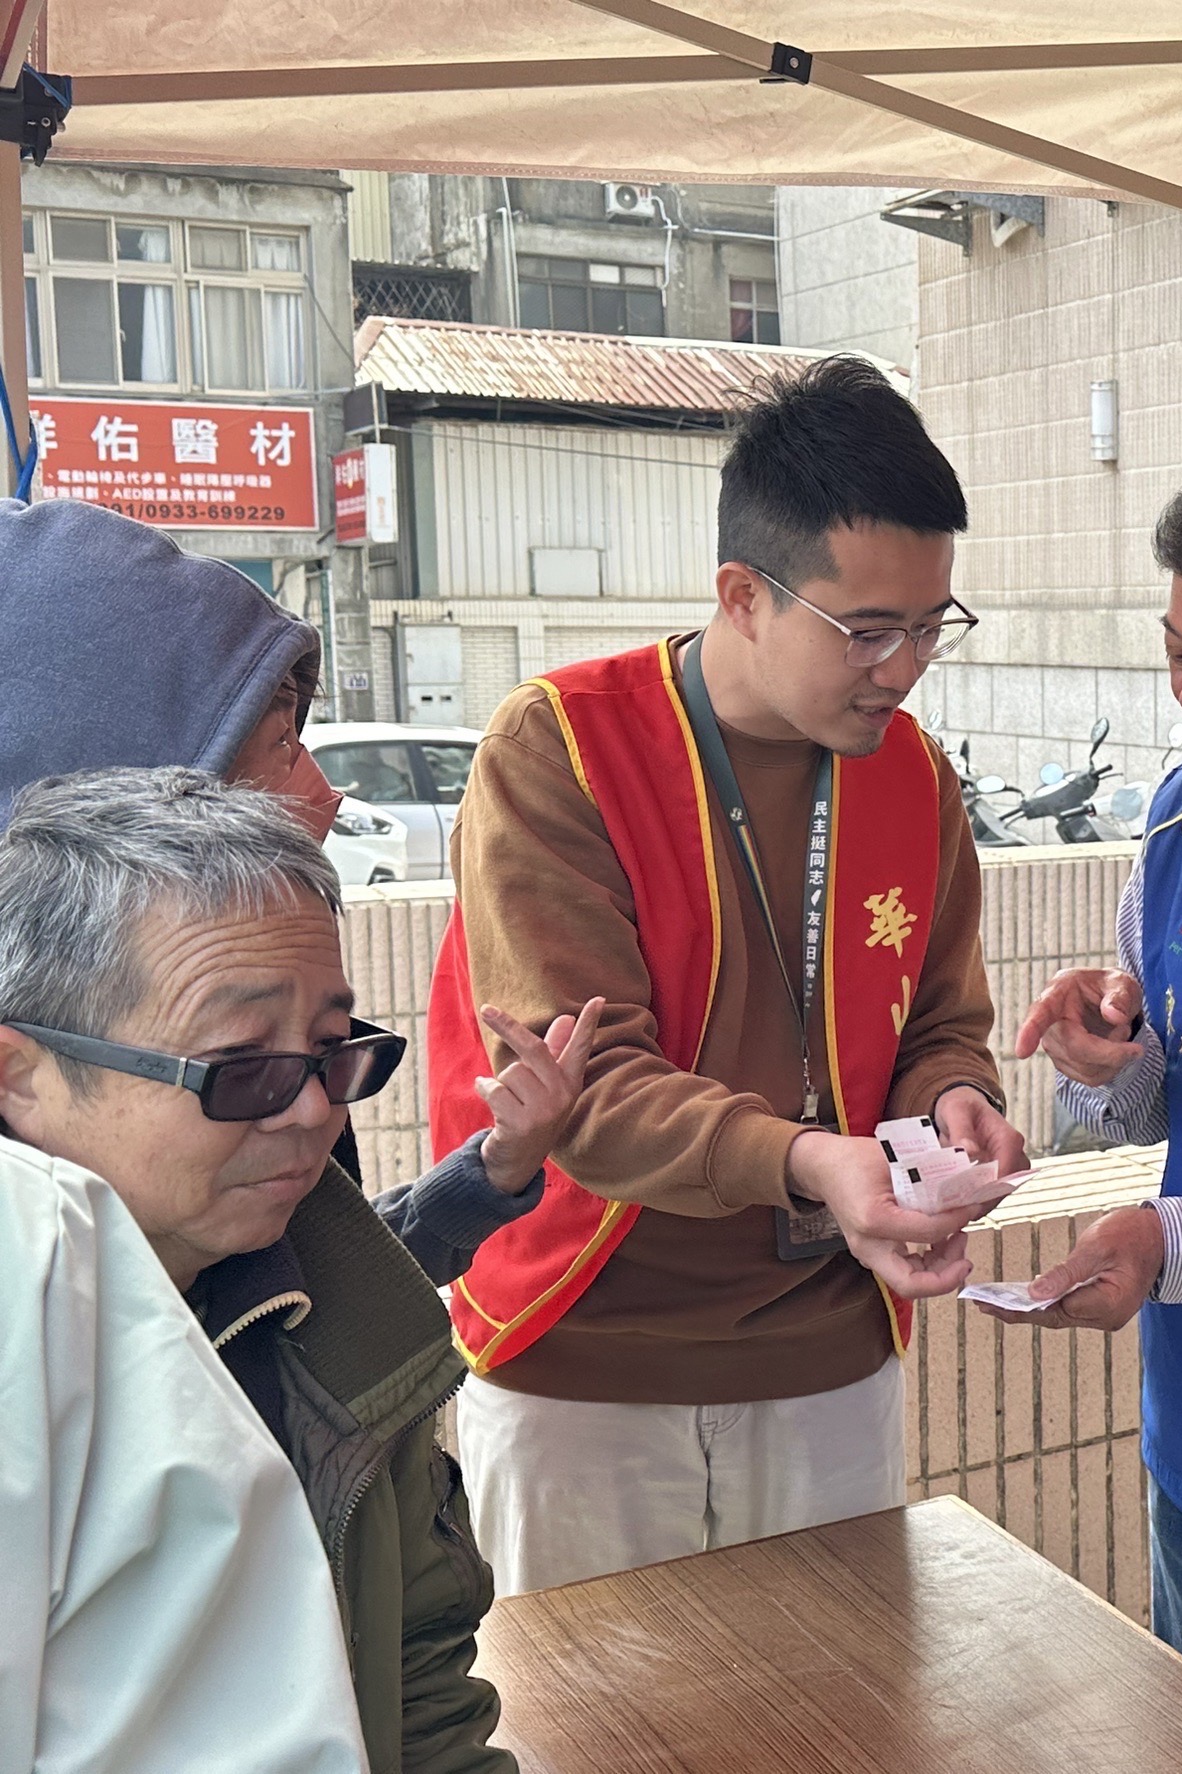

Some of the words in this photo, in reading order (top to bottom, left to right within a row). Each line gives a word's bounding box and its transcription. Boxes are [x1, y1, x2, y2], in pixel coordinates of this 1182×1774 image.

[101, 502, 286, 521] 91/0933-699229
[808, 801, 828, 885] 民主挺同志
[805, 911, 822, 979] 友善日常
